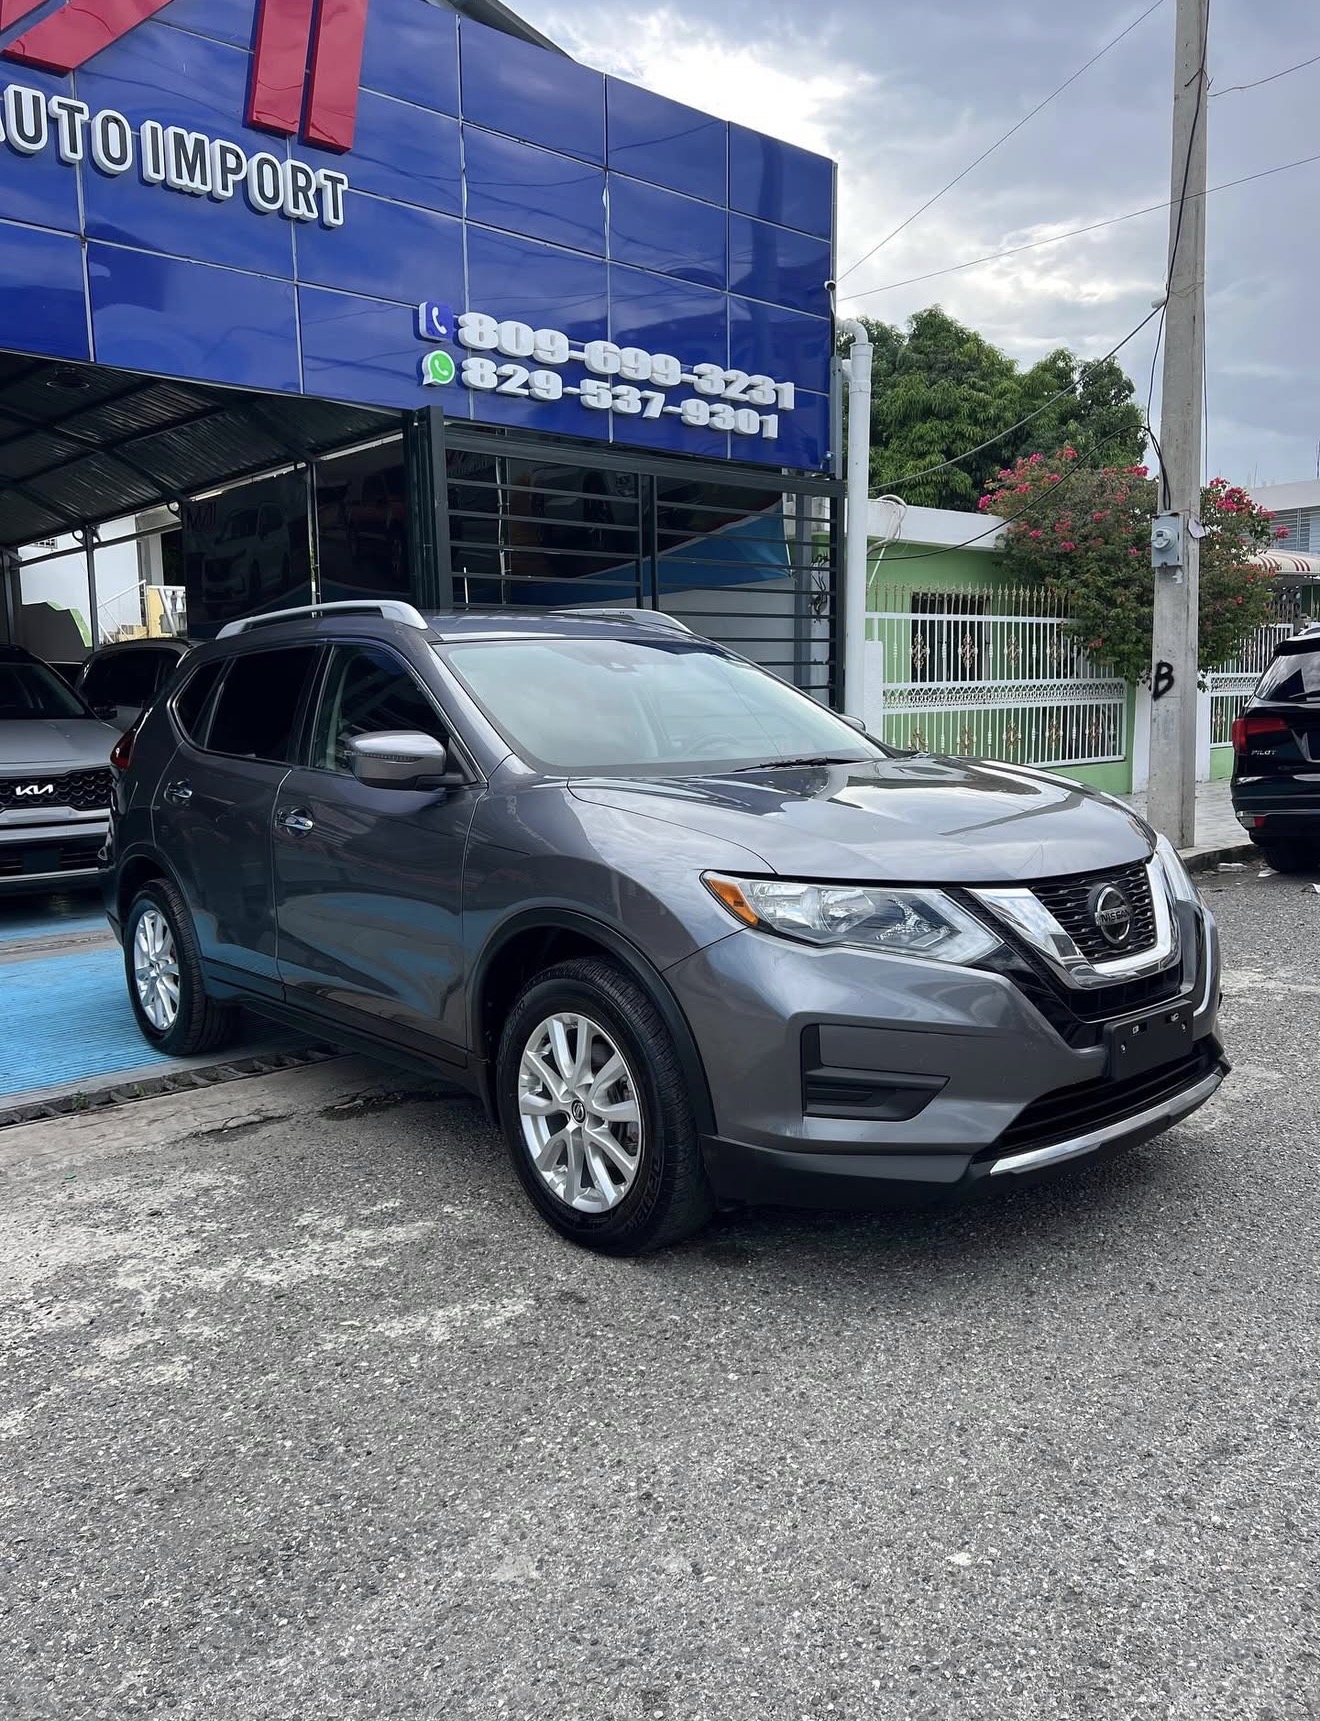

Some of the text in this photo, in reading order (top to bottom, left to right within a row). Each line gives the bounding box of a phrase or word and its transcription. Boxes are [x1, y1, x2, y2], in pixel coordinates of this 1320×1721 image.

[0, 84, 349, 228] UTO IMPORT
[458, 312, 795, 411] 809-699-3231
[461, 357, 779, 440] 829-537-9301
[1152, 661, 1175, 701] B
[1100, 908, 1130, 923] NISSAN
